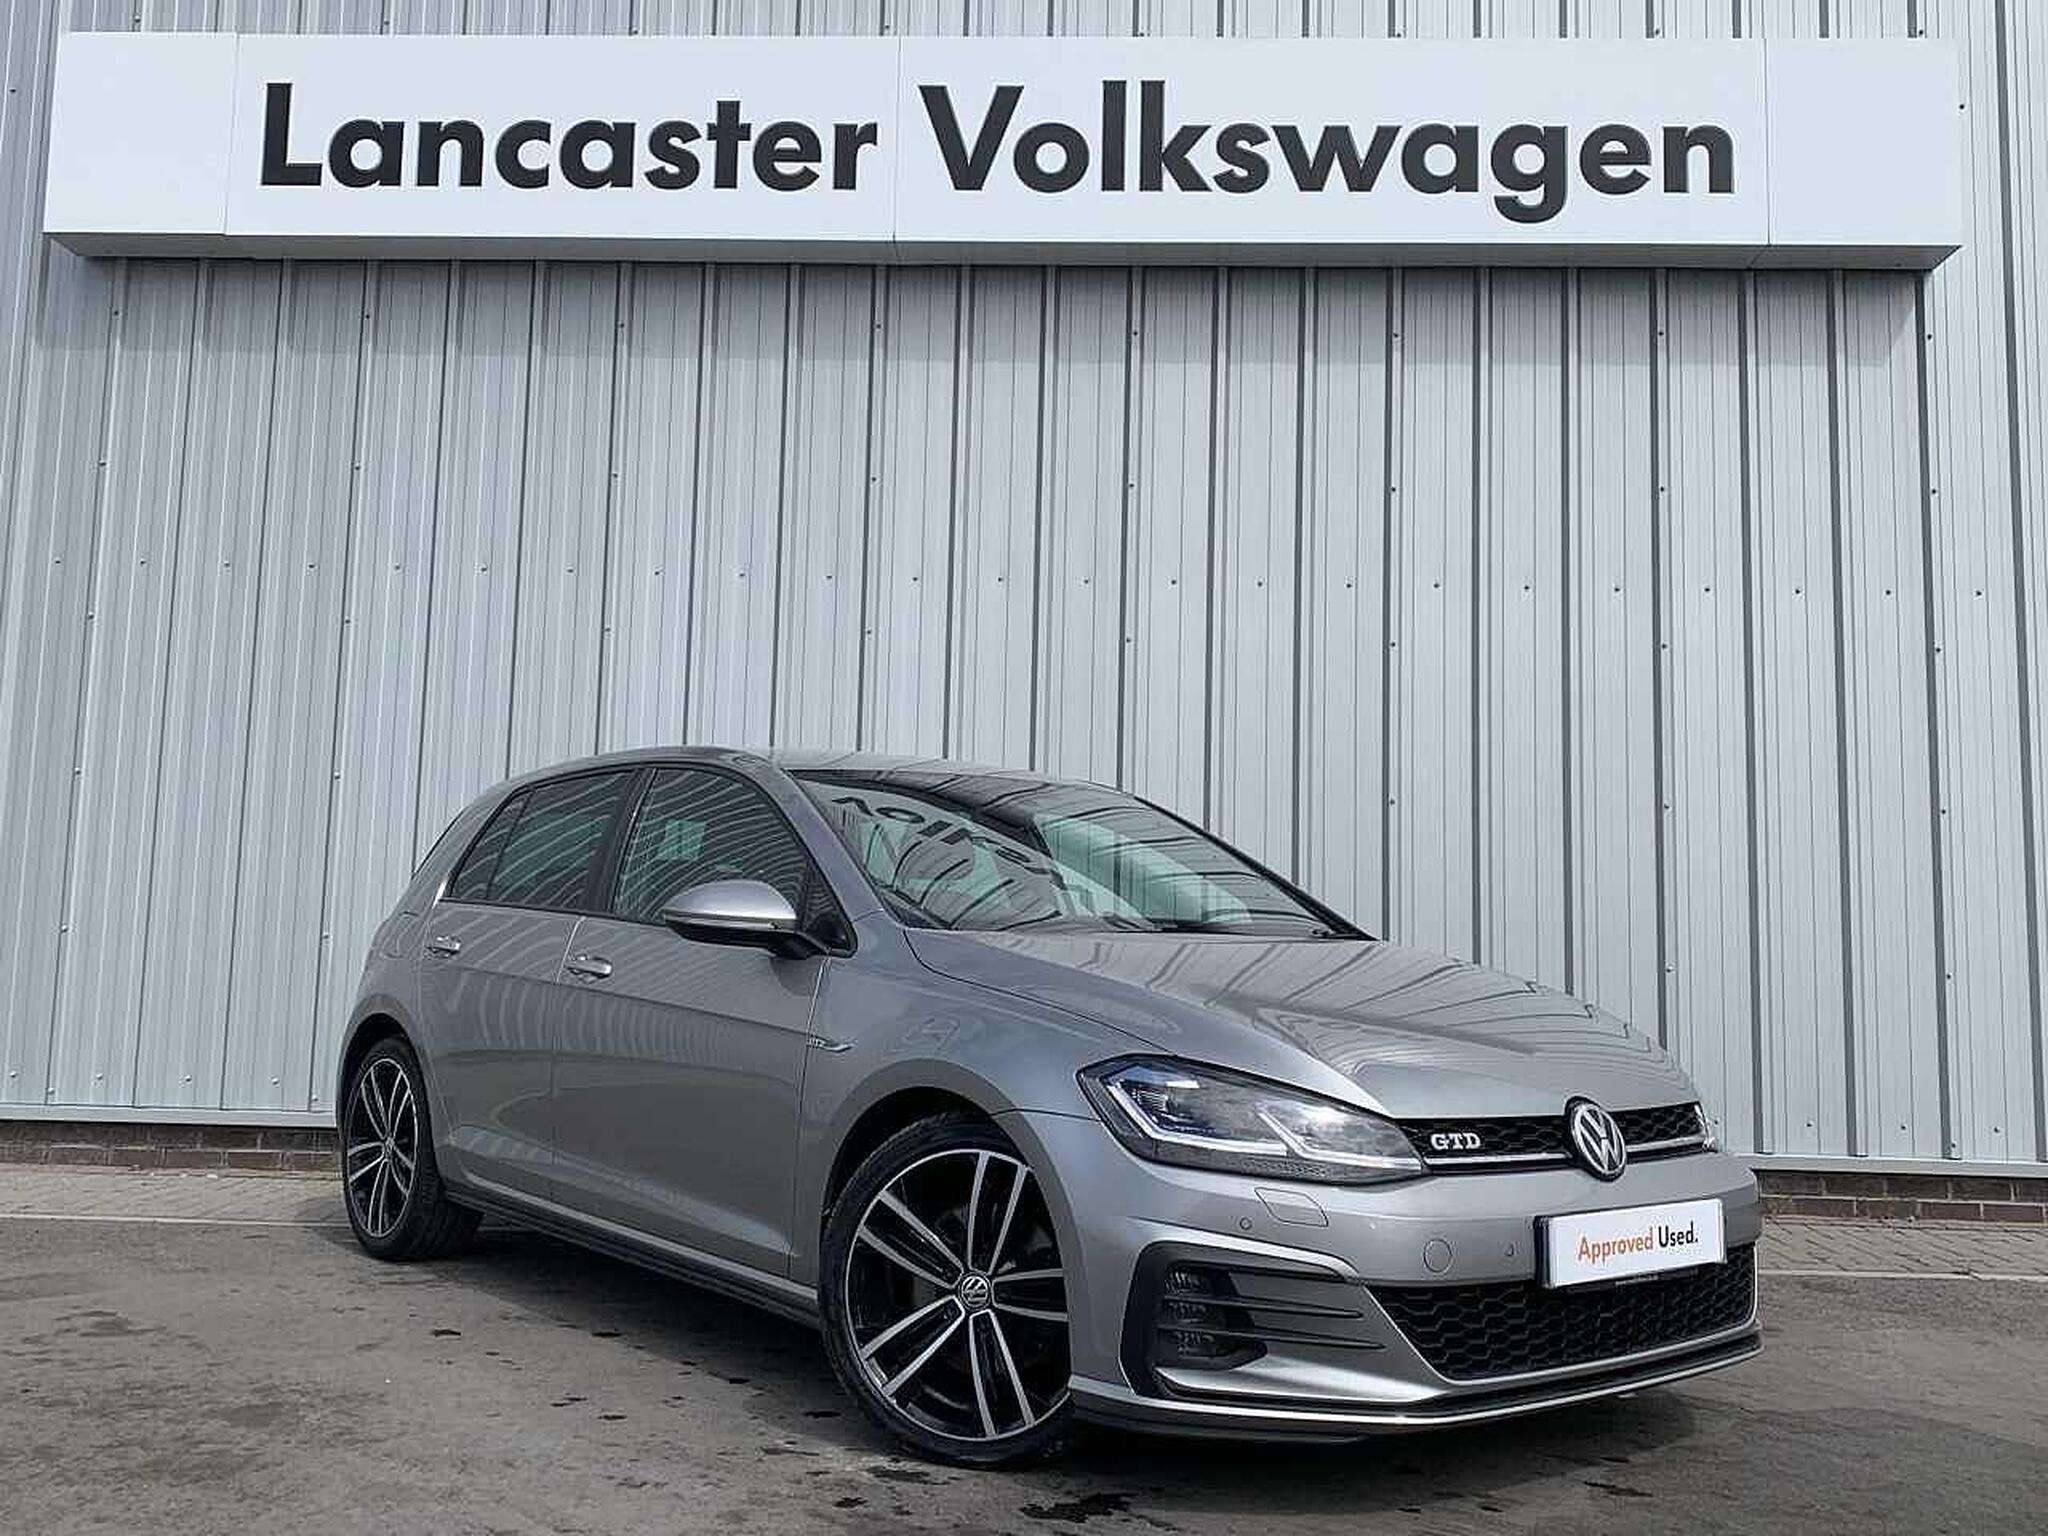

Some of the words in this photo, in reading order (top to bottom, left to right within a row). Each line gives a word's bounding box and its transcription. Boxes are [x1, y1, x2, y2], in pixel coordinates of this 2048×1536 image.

[260, 82, 878, 191] Lancaster
[919, 80, 1734, 224] Volkswagen
[1430, 1132, 1481, 1151] GTD
[1577, 1226, 1654, 1265] Approved
[1657, 1219, 1699, 1248] Used.
